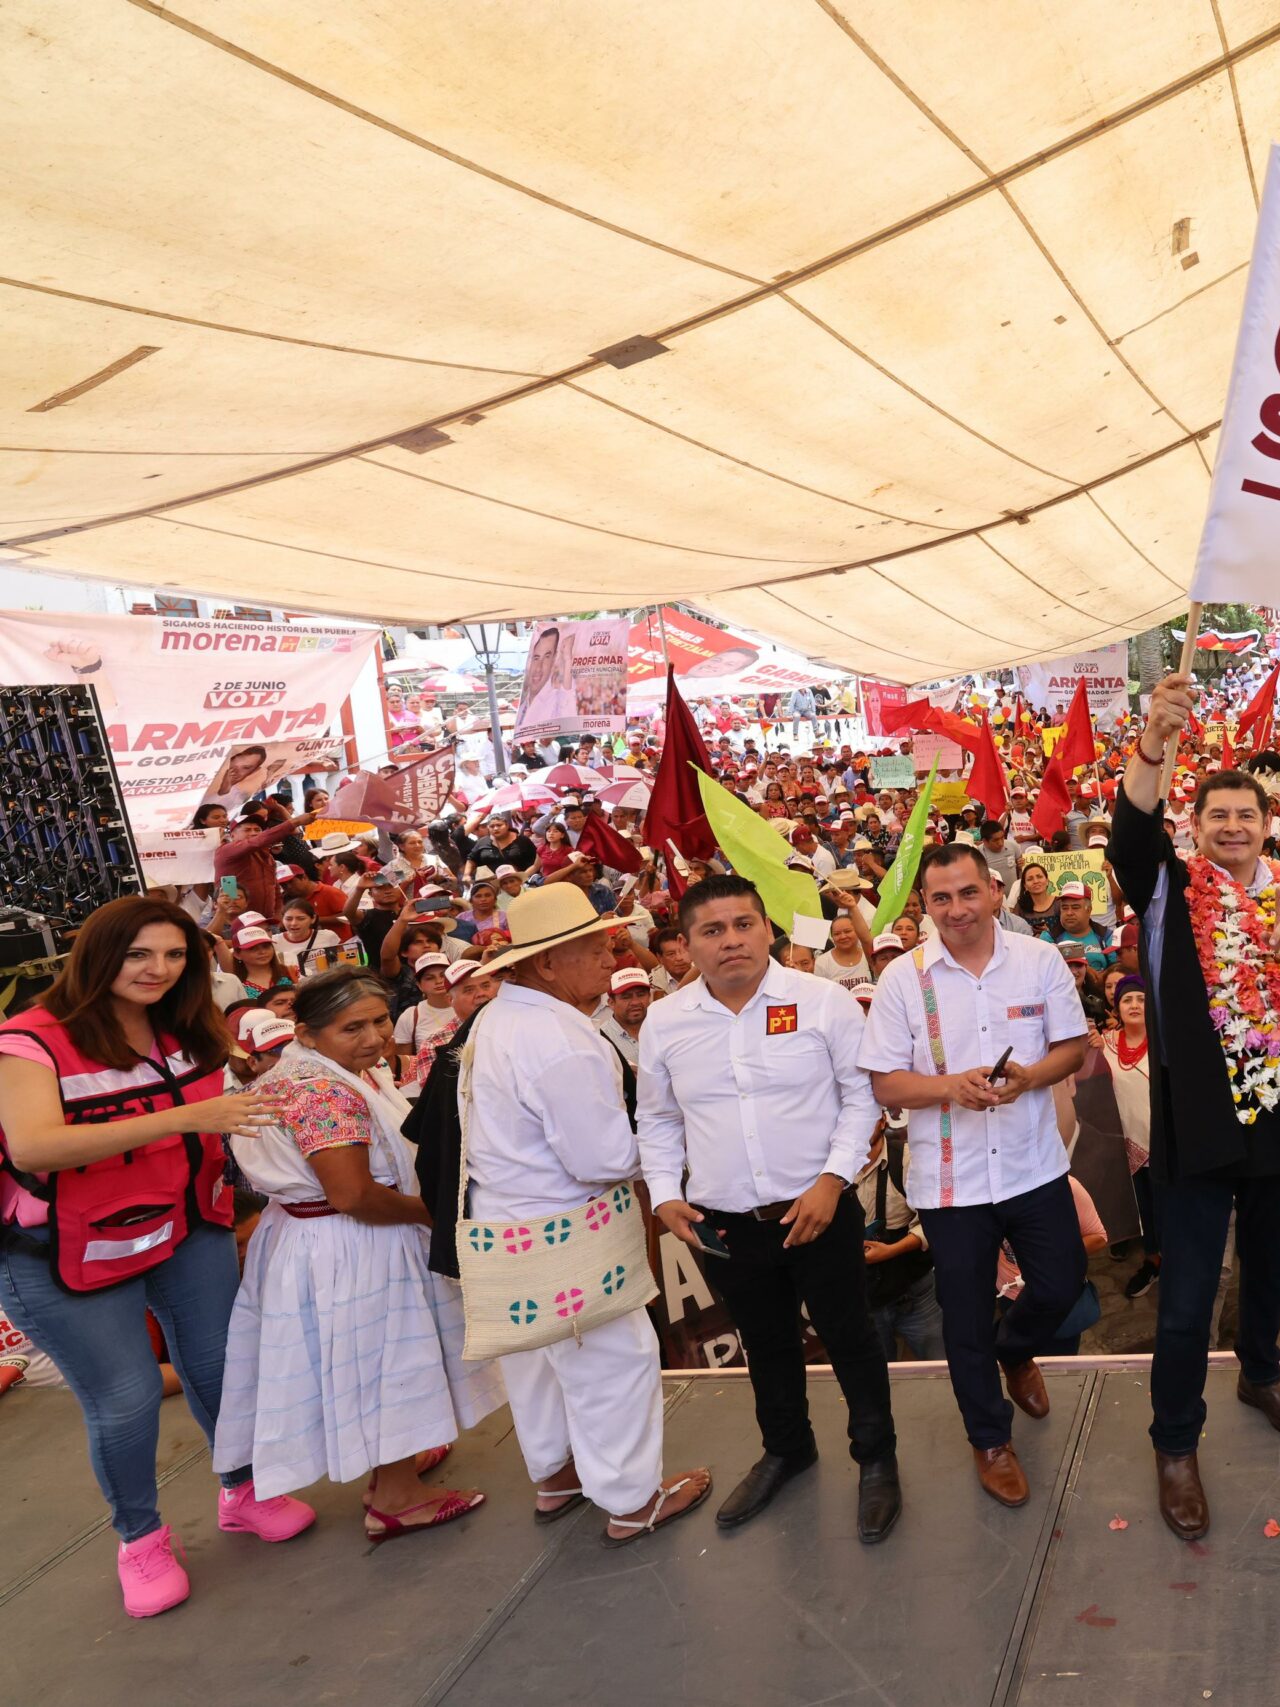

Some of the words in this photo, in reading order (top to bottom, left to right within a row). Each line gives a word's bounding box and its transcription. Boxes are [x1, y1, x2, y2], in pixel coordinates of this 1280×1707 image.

[162, 620, 211, 629] SIGAMOS
[213, 622, 264, 631] HACIENDO
[266, 625, 308, 634] HISTORIA
[160, 631, 276, 652] morena
[281, 642, 296, 650] PT
[572, 656, 597, 666] PROFE
[597, 655, 623, 665] OMAR
[213, 682, 221, 691] 2
[223, 682, 243, 690] DE
[245, 681, 286, 690] JUNIO
[1048, 677, 1125, 688] ARMENTA
[208, 691, 281, 708] VOTA
[105, 702, 327, 752] ARMENTA
[583, 719, 611, 728] morena
[296, 738, 345, 752] OLINTLA
[769, 1015, 795, 1033] PT
